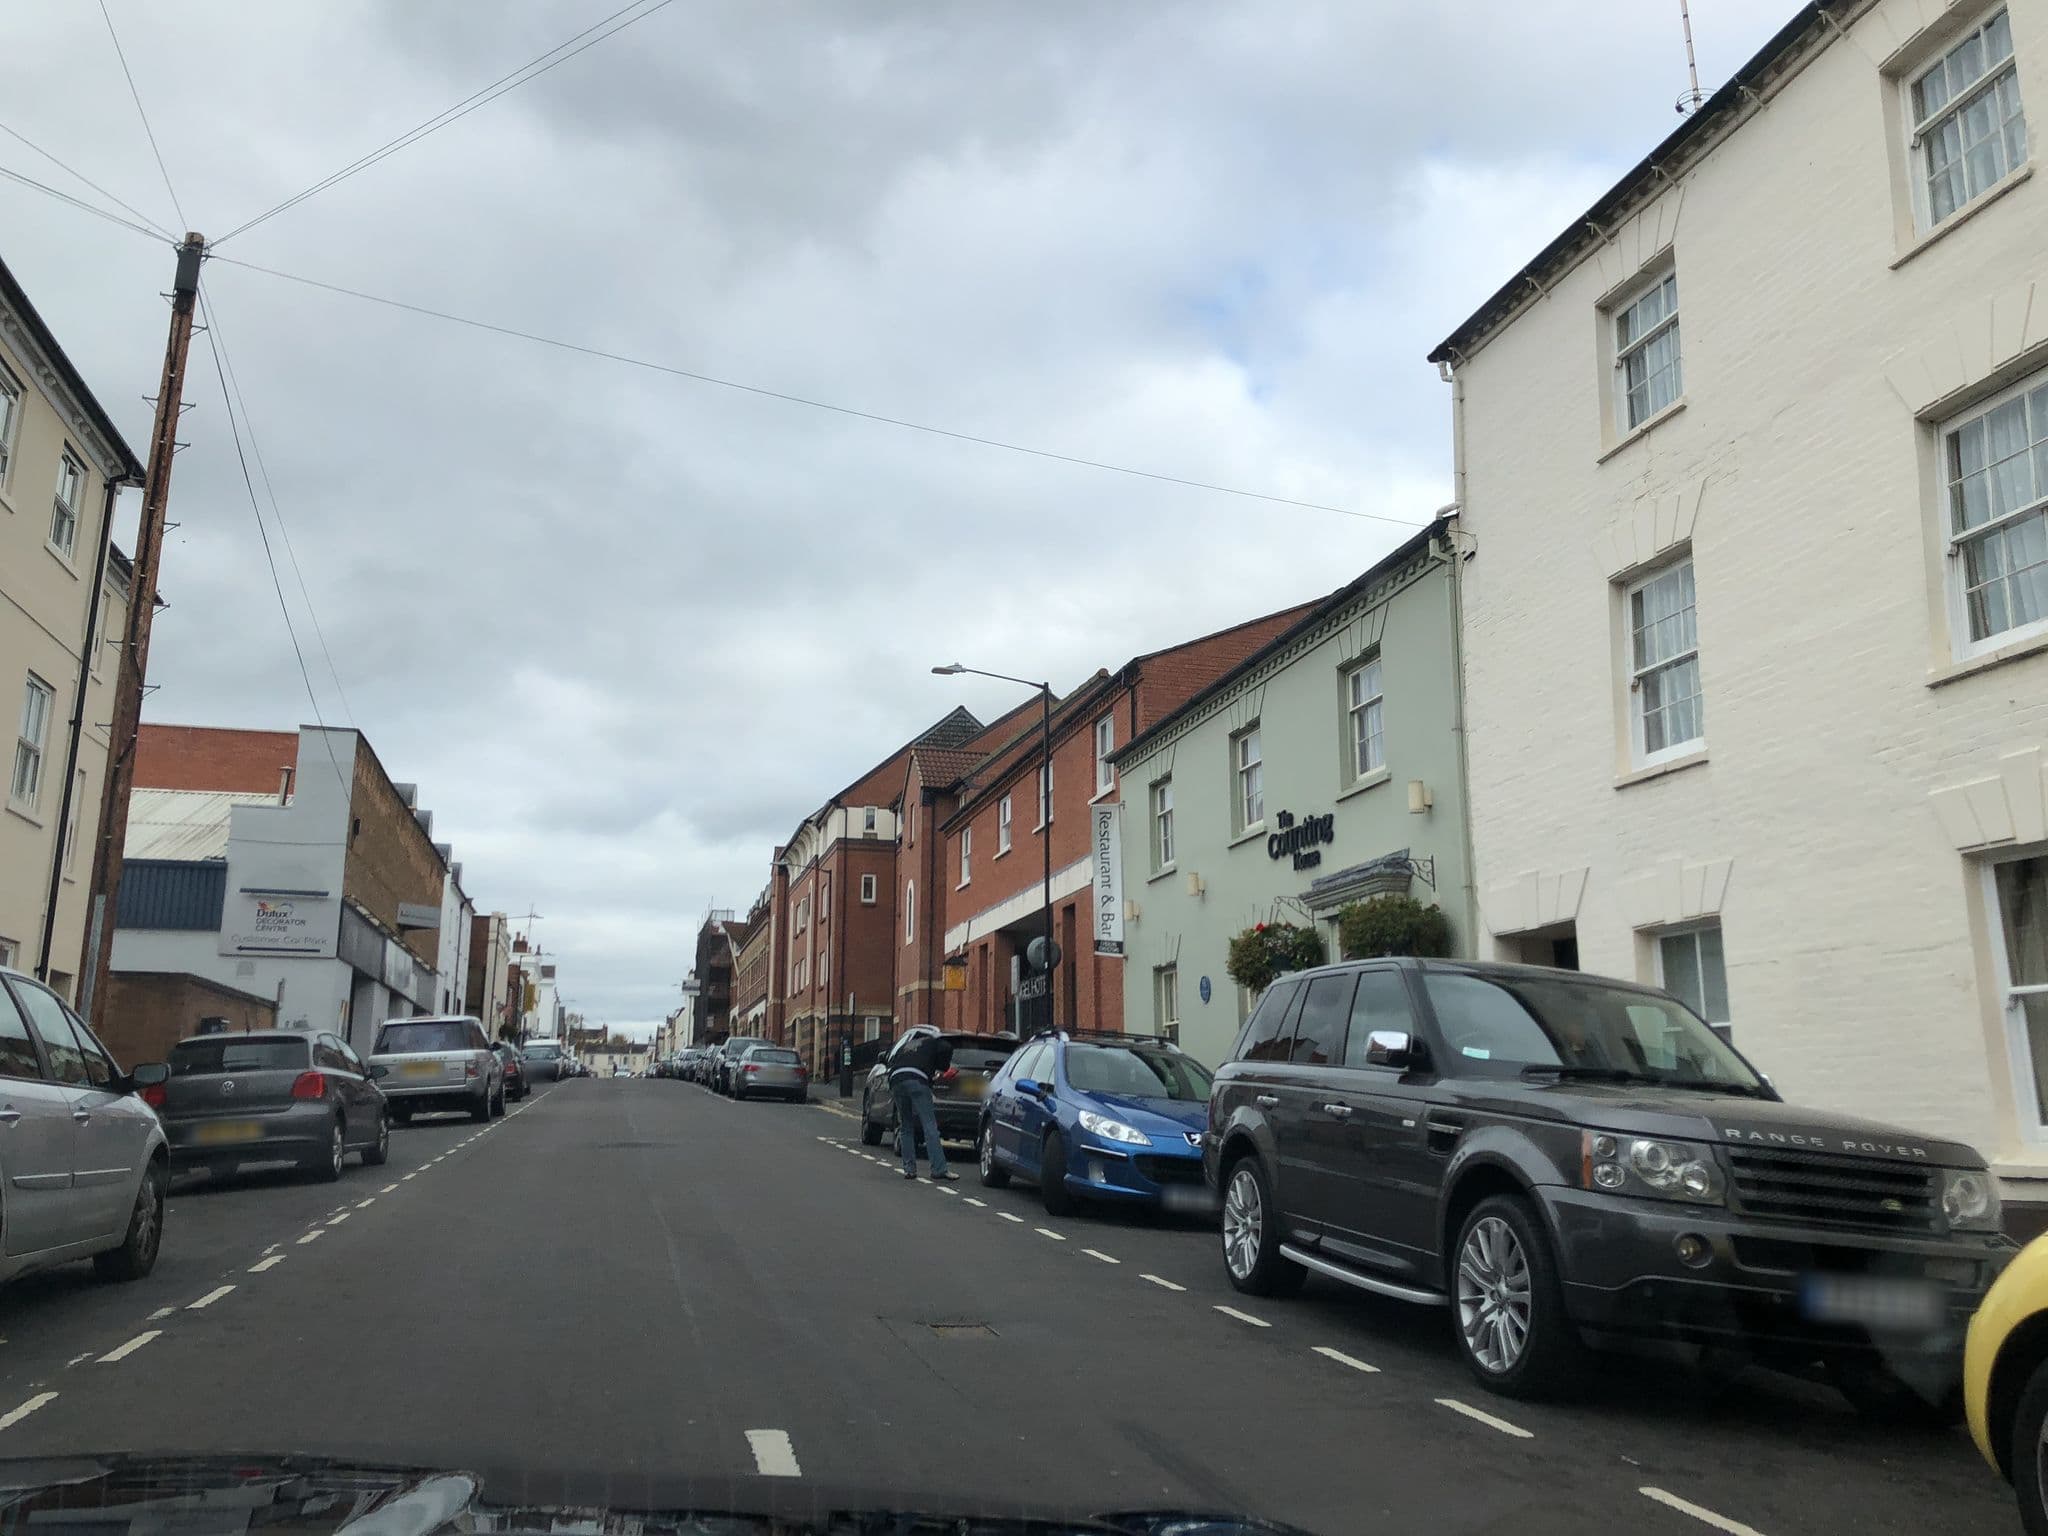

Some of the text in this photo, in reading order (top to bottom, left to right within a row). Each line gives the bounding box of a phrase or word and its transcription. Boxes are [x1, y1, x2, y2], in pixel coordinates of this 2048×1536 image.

[1268, 813, 1333, 860] Counting
[1099, 810, 1112, 889] Restaurant
[1101, 895, 1114, 908] &
[256, 918, 306, 927] DECORATOR
[257, 909, 287, 918] Dulux
[1101, 913, 1115, 937] Bar
[283, 935, 301, 945] Car
[1724, 1128, 1927, 1157] RANGE ROVER
